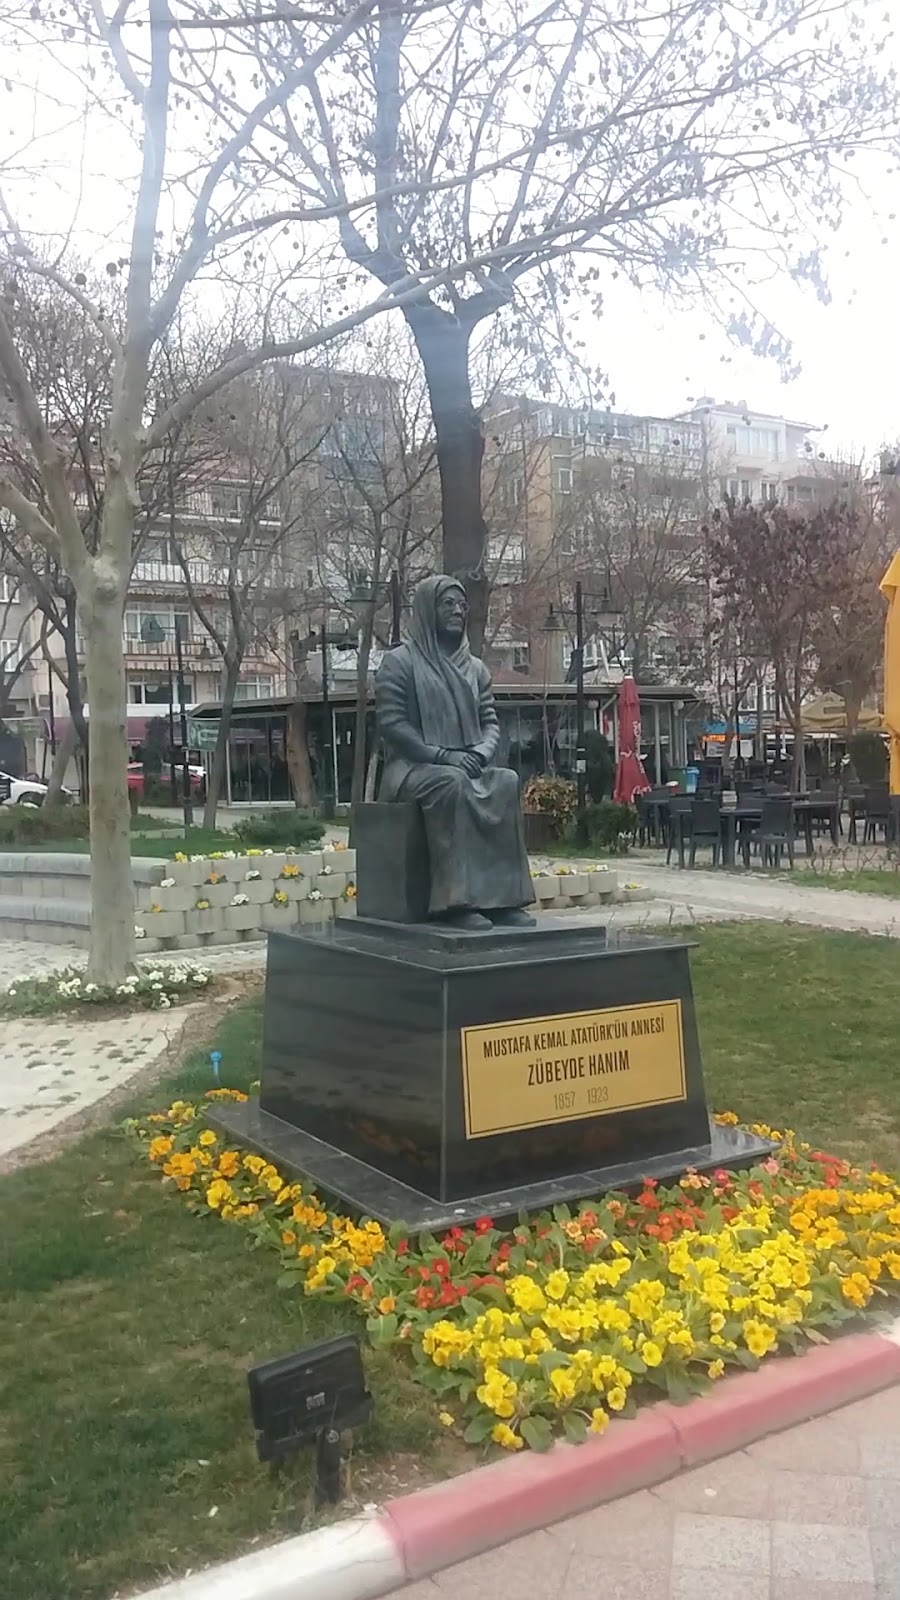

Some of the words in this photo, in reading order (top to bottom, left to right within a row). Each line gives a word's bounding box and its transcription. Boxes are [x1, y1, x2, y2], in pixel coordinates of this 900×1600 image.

[483, 1035, 532, 1058] MUSTAFA
[534, 1030, 569, 1051] KEMAL
[571, 1019, 628, 1046] ATATÜRK'ÜN
[631, 1013, 665, 1037] ANNESİ
[528, 1058, 586, 1086] ZÜBEYDE
[589, 1050, 630, 1076] HANIM
[554, 1091, 576, 1111] 1857
[587, 1086, 609, 1105] 1923
